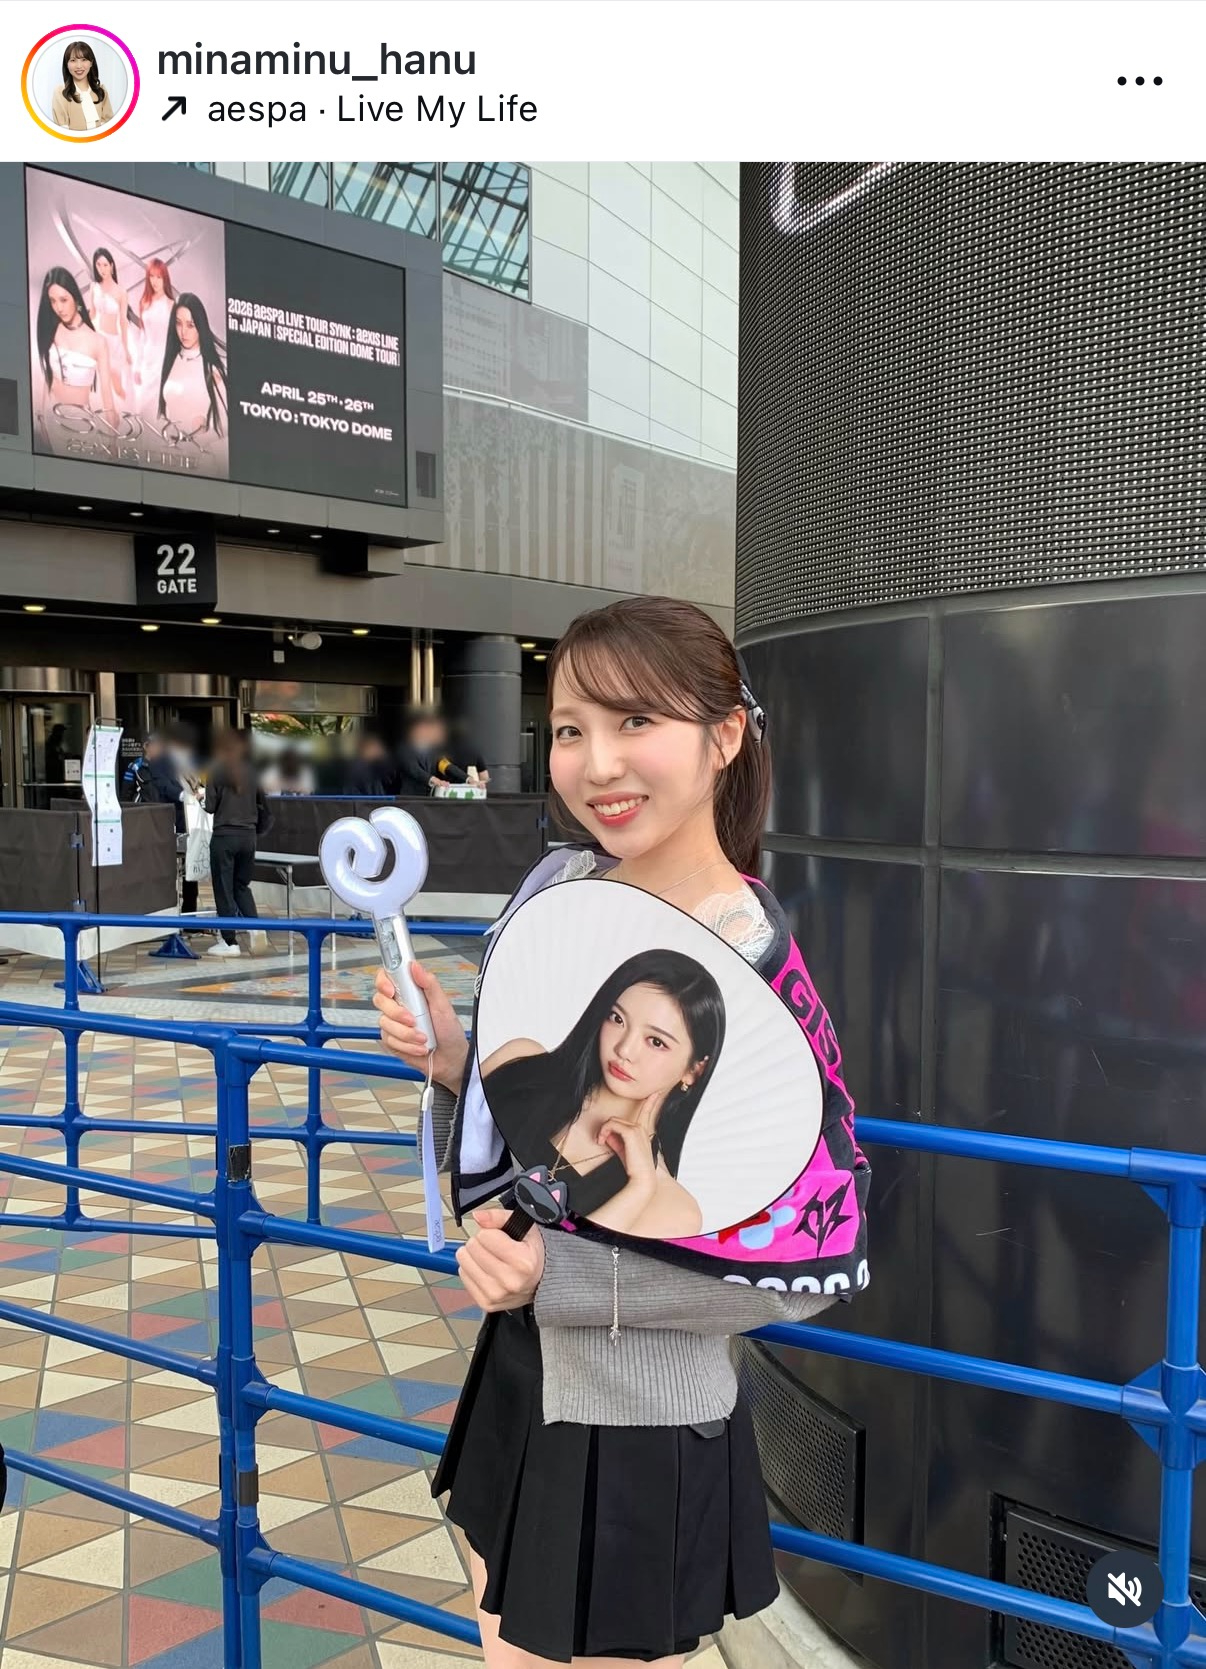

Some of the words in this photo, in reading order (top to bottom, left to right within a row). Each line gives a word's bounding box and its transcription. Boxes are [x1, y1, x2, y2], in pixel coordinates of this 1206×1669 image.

[228, 298, 253, 317] 2026
[286, 312, 305, 329] LIVE
[305, 316, 329, 335] TOUR
[329, 322, 352, 341] SYNK
[381, 334, 399, 351] LINE
[228, 315, 239, 331] in
[240, 318, 272, 338] JAPAN
[315, 334, 349, 355] EDITION
[350, 342, 375, 361] DOME
[261, 382, 305, 402] APRIL
[240, 401, 293, 423] TOKYO
[300, 412, 350, 433] TOKYO
[351, 422, 393, 441] DOME
[156, 543, 196, 576] 22
[157, 578, 197, 594] GATE
